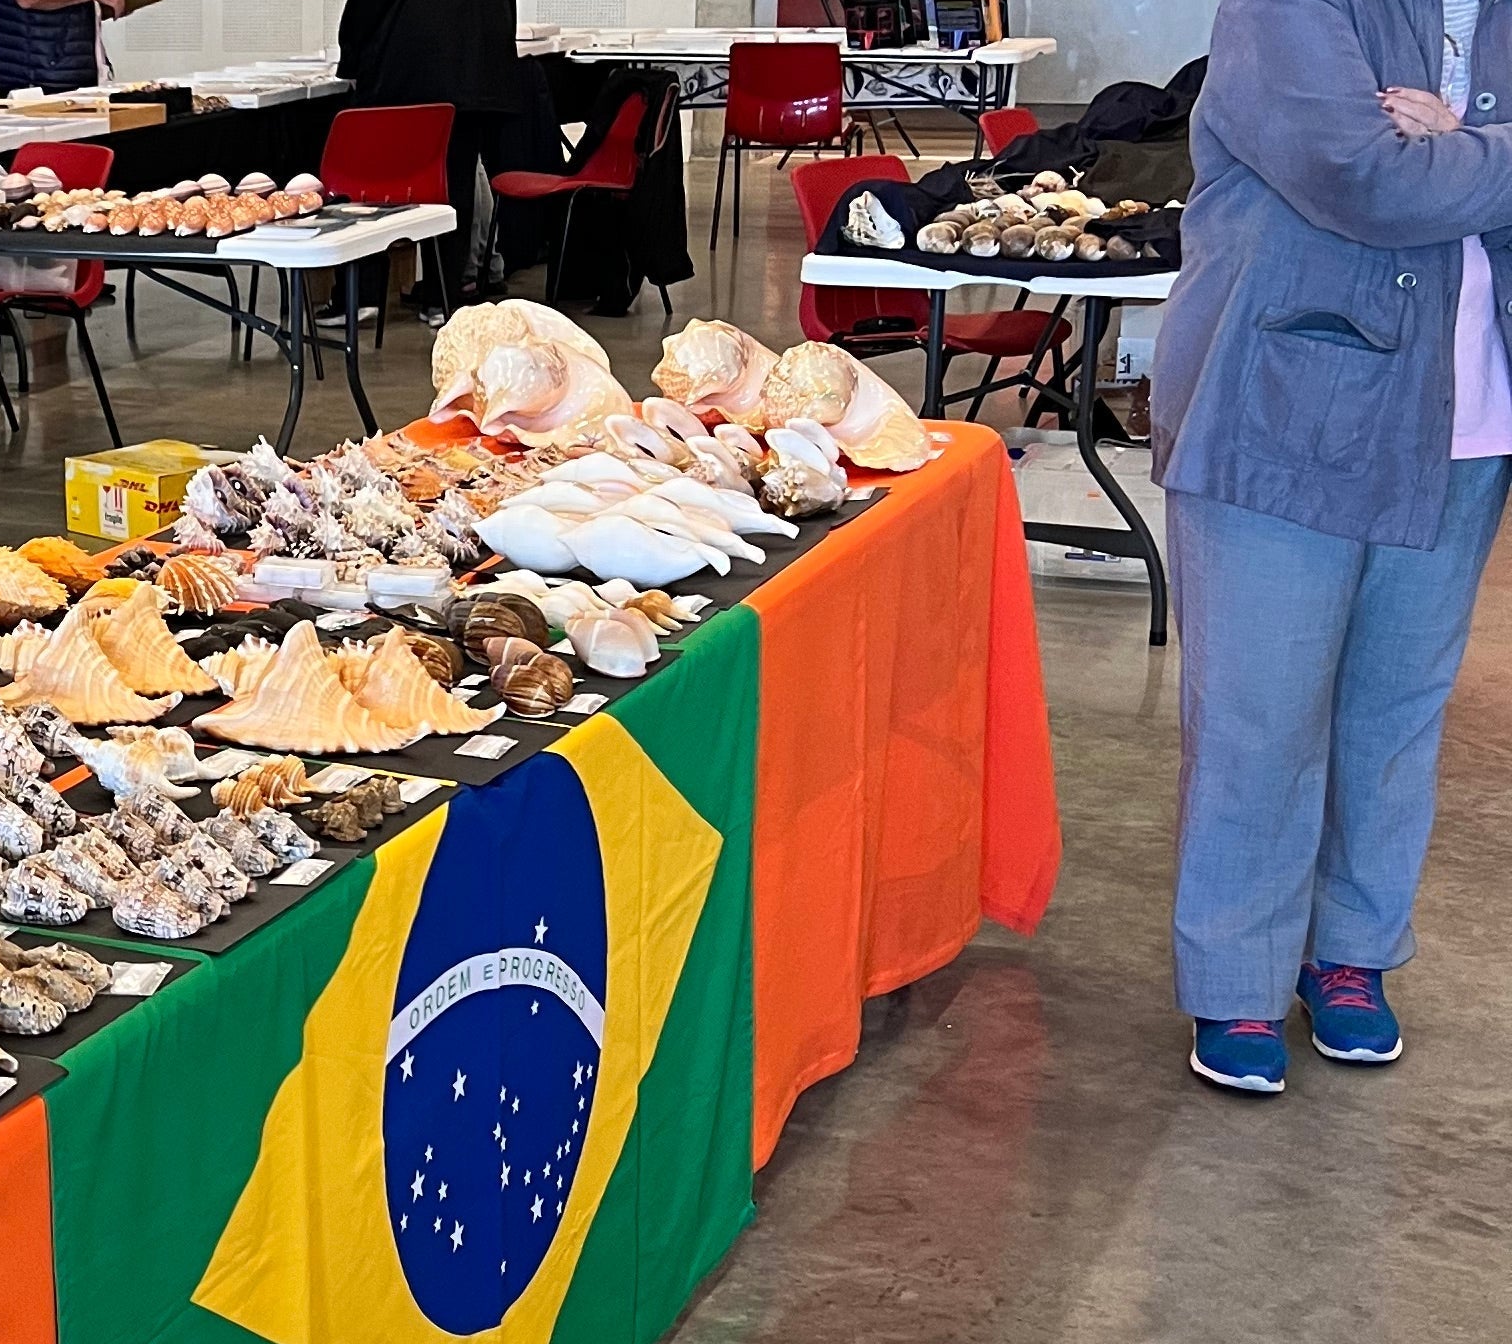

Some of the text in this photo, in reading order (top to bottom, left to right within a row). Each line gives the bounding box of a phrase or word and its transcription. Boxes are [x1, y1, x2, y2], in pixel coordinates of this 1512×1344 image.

[118, 478, 148, 493] DHL
[409, 956, 586, 1030] ORDEM E PROGRESSO
